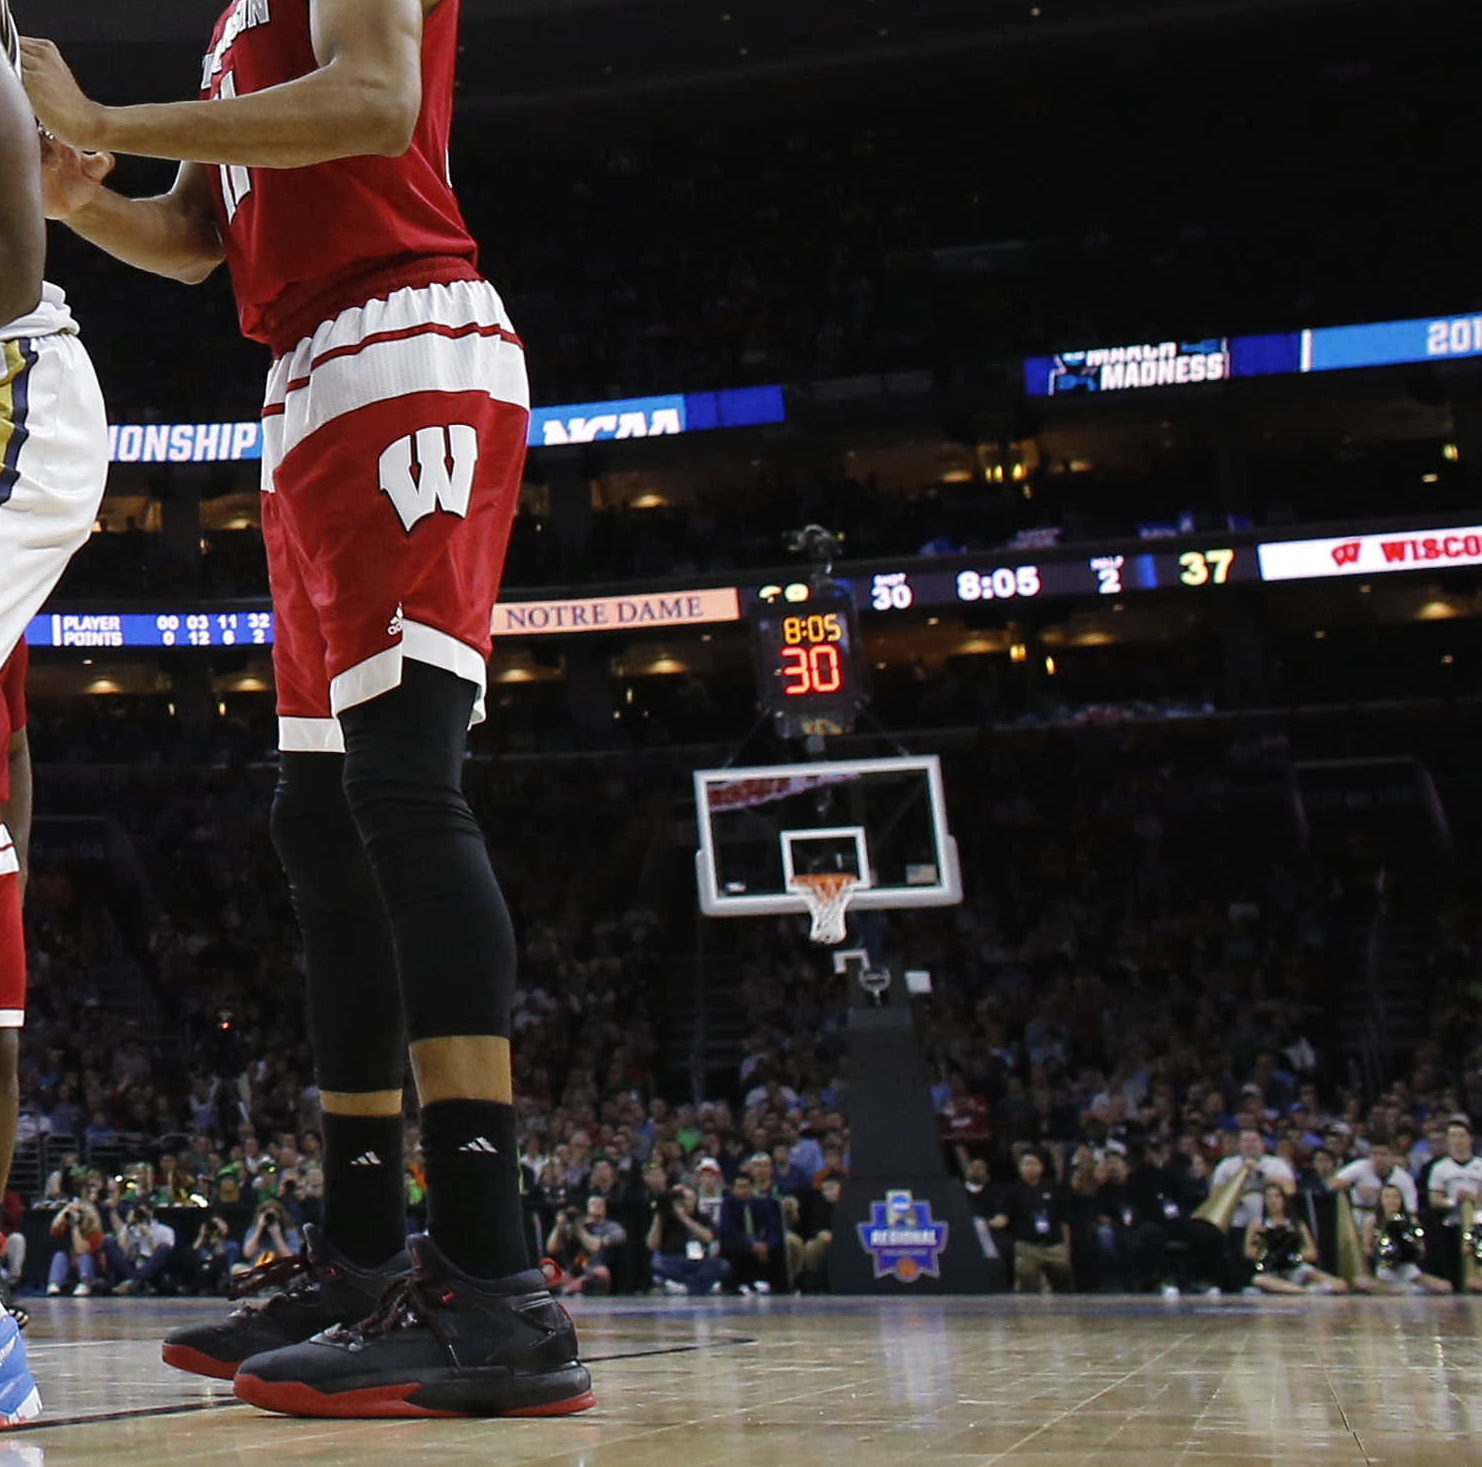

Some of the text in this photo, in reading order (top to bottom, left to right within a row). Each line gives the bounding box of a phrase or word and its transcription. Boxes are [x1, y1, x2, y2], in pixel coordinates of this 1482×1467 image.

[1427, 317, 1482, 356] 201
[1101, 352, 1224, 391] MADNESS
[108, 422, 258, 463] IONSHIP
[542, 408, 682, 445] NCAA
[378, 424, 479, 533] W
[1179, 548, 1235, 586] 37
[1380, 535, 1482, 563] WISCO
[871, 584, 913, 612] 30
[956, 565, 1041, 601] 8:05
[1098, 569, 1123, 594] 2
[63, 612, 271, 631] PLAYER 00 03 11 32
[506, 596, 705, 631] NOTRE DAME
[783, 613, 842, 644] 8:05
[63, 631, 123, 647] POINTS
[162, 631, 176, 646] 0
[188, 631, 211, 646] 12
[252, 629, 265, 644] 2
[780, 643, 842, 695] 30
